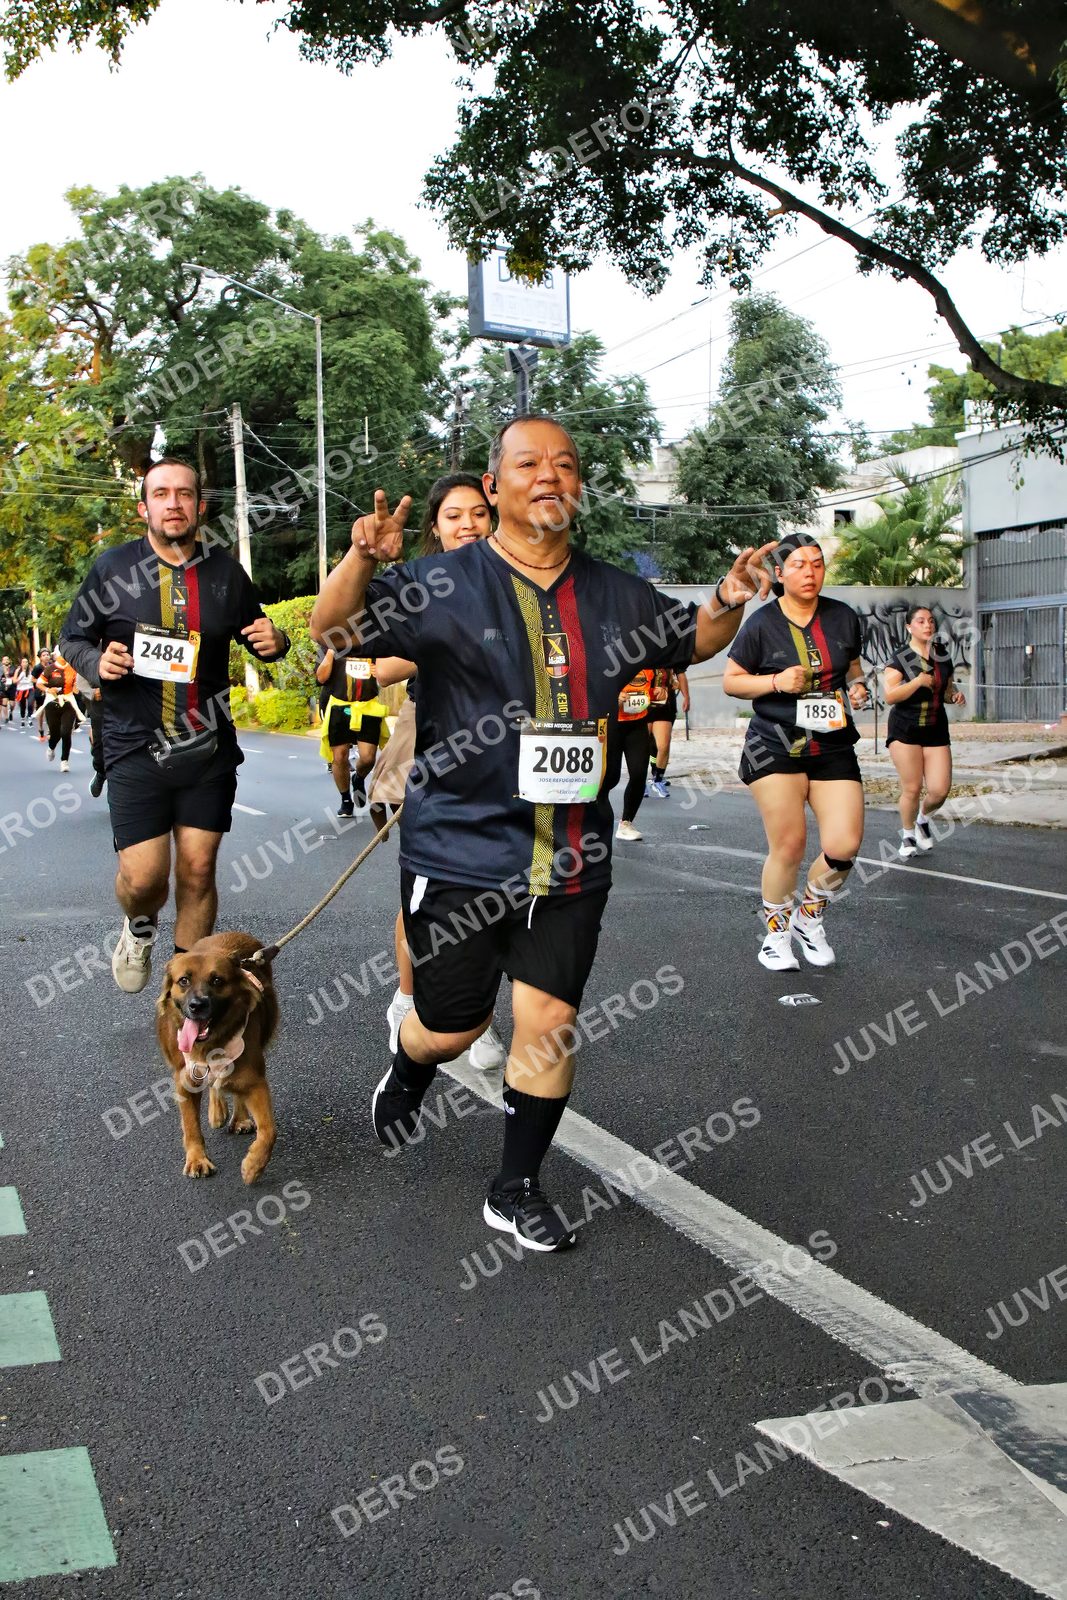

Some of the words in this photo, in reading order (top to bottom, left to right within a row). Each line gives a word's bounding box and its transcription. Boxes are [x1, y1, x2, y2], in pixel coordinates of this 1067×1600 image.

[141, 641, 184, 663] 2484
[628, 699, 645, 707] 1449
[805, 704, 836, 719] 1858
[533, 746, 594, 773] 2088
